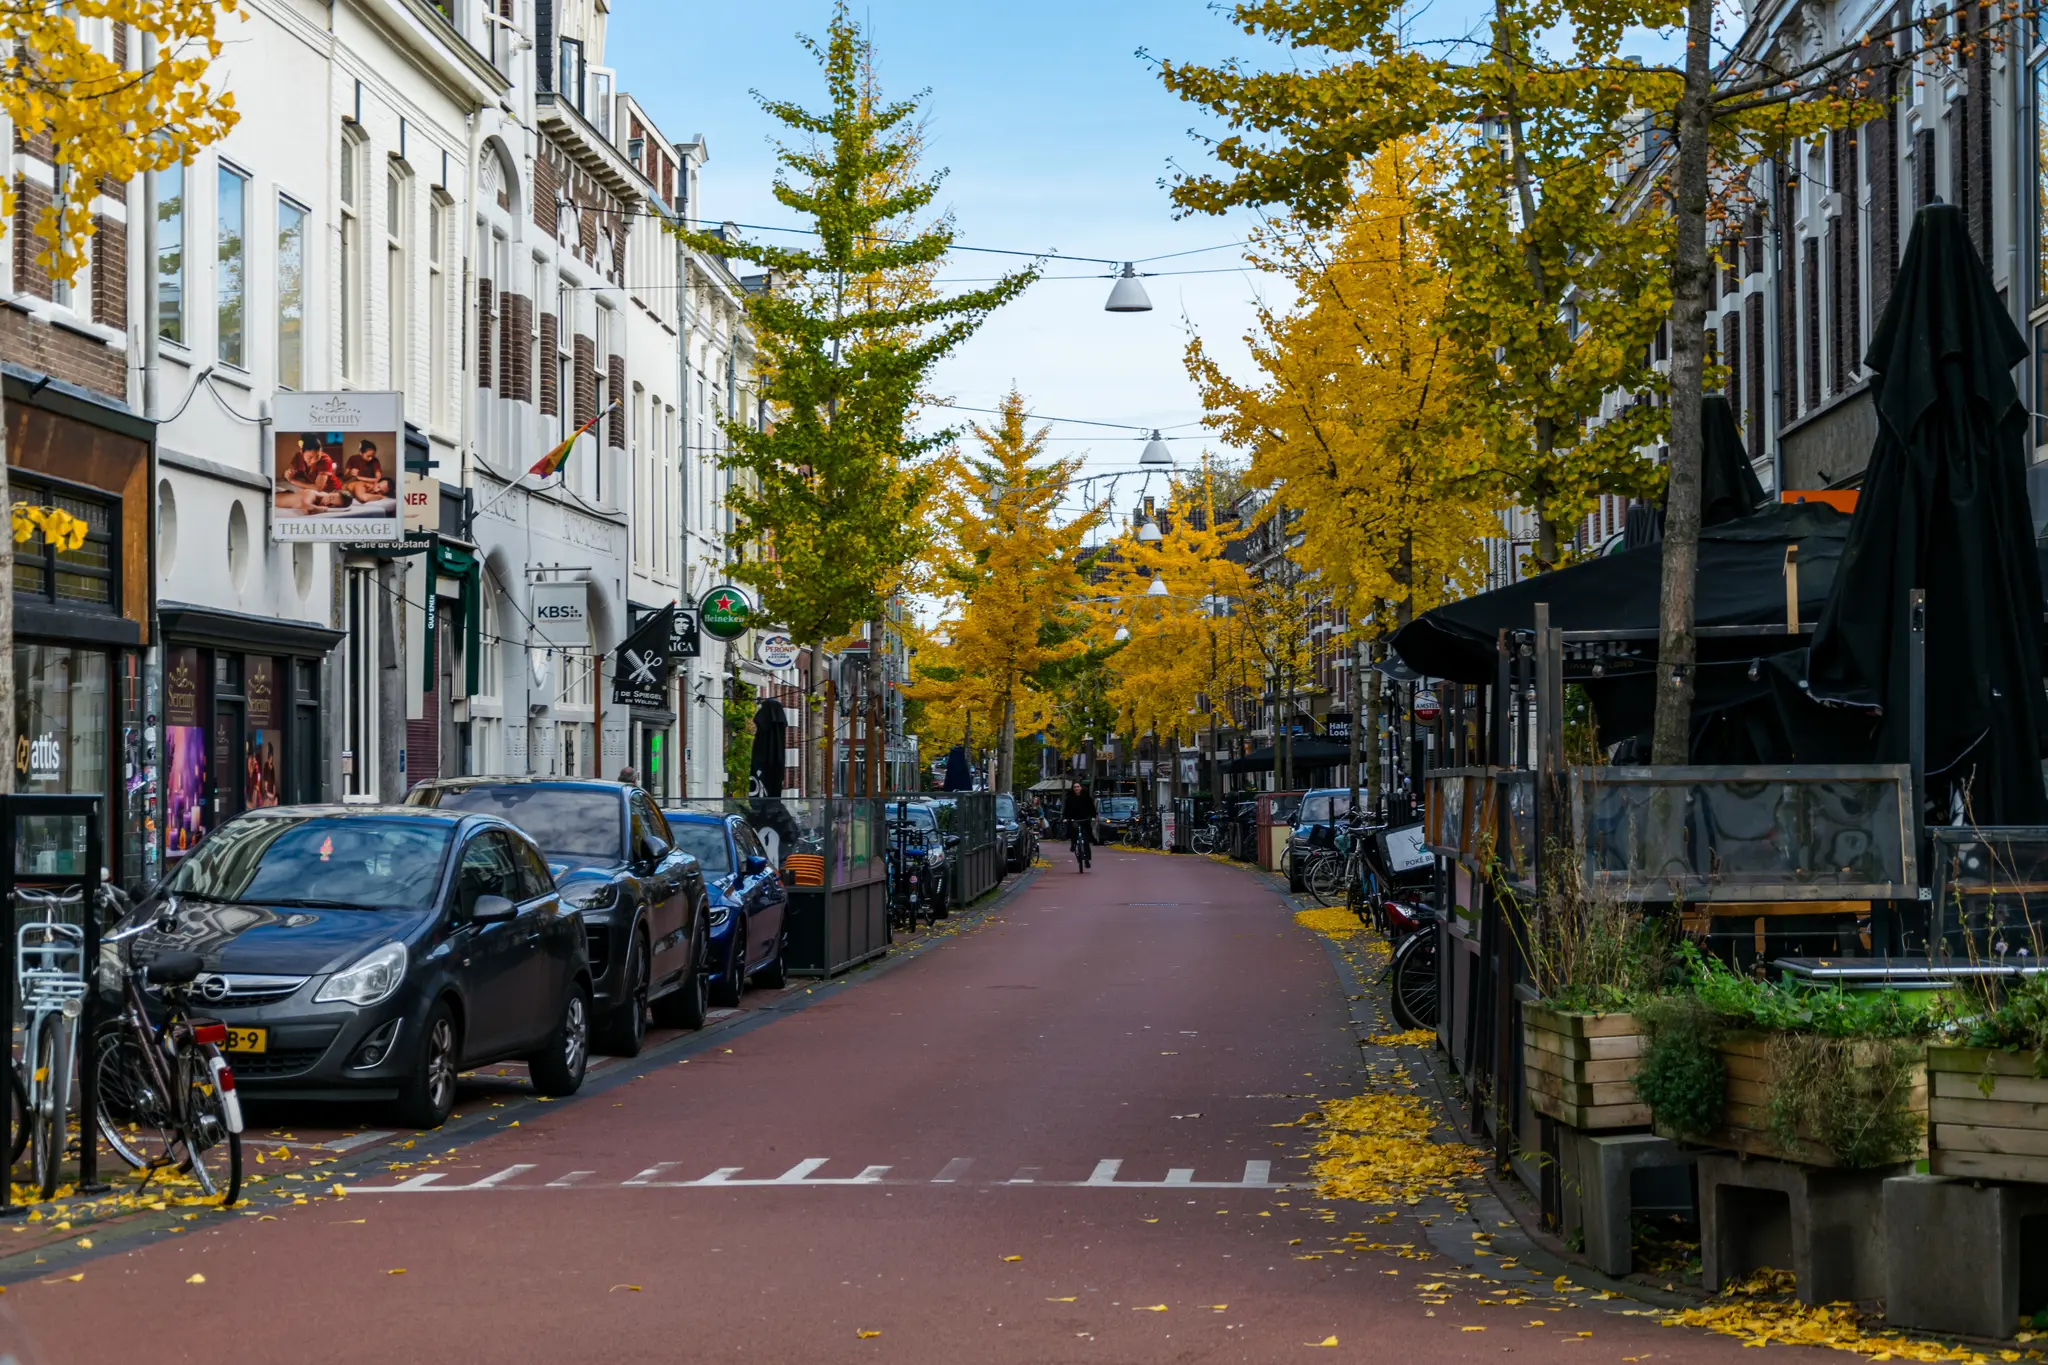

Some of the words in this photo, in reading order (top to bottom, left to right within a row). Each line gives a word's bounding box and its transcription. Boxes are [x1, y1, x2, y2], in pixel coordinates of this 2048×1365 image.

[309, 411, 361, 425] Serenity
[404, 493, 427, 506] NER
[279, 523, 316, 535] THAI
[321, 523, 391, 535] MASSAGE
[538, 606, 570, 618] KBS
[704, 614, 744, 623] Heineken
[1329, 729, 1349, 737] Look
[31, 731, 60, 769] attis
